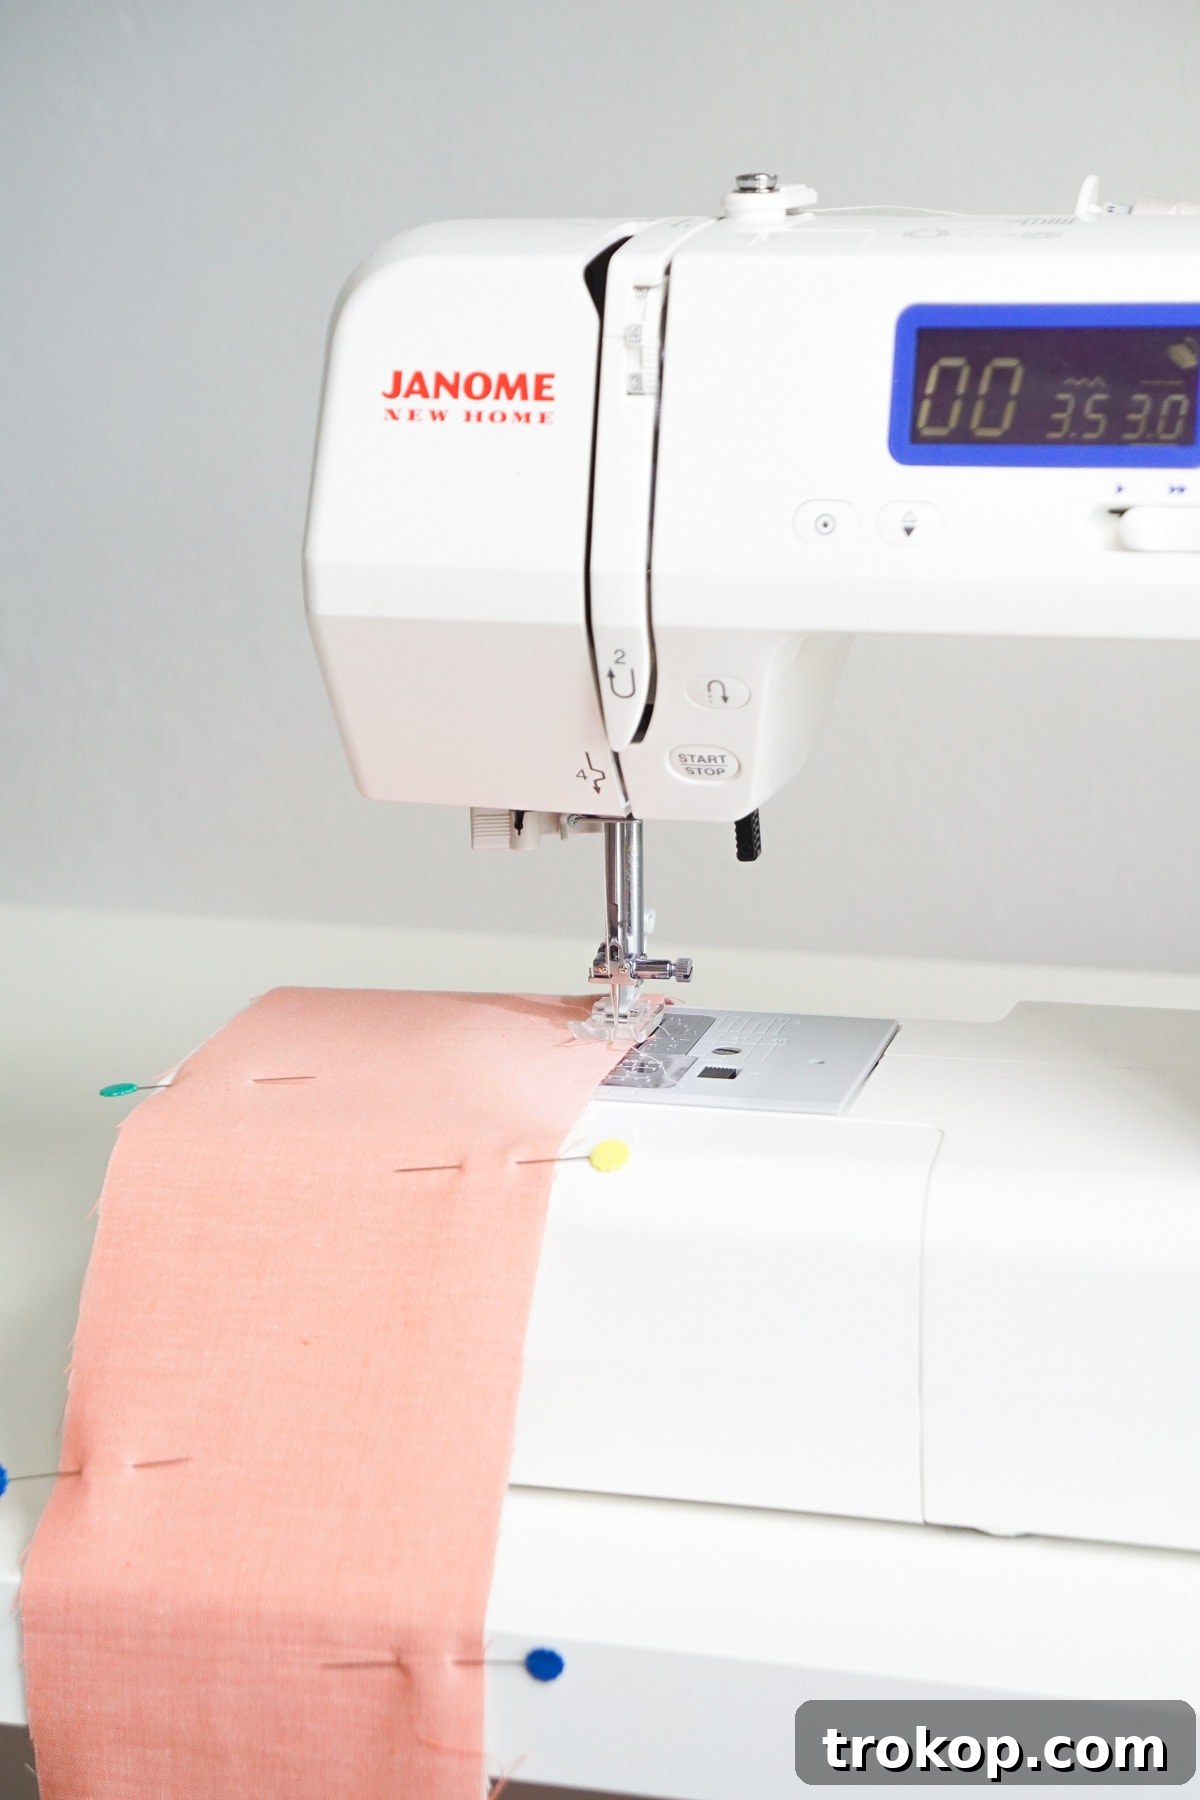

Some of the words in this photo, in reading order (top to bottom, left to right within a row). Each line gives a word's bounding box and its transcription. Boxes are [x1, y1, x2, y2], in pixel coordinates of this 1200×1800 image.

[382, 370, 555, 402] JANOME
[917, 357, 1024, 437] 00
[1046, 393, 1109, 440] 3.5
[1122, 393, 1188, 440] 3.0
[384, 408, 448, 422] NEW
[464, 409, 553, 424] HOME
[614, 649, 626, 664] 2
[678, 753, 727, 764] START
[576, 769, 587, 780] 4
[685, 766, 725, 776] STOP
